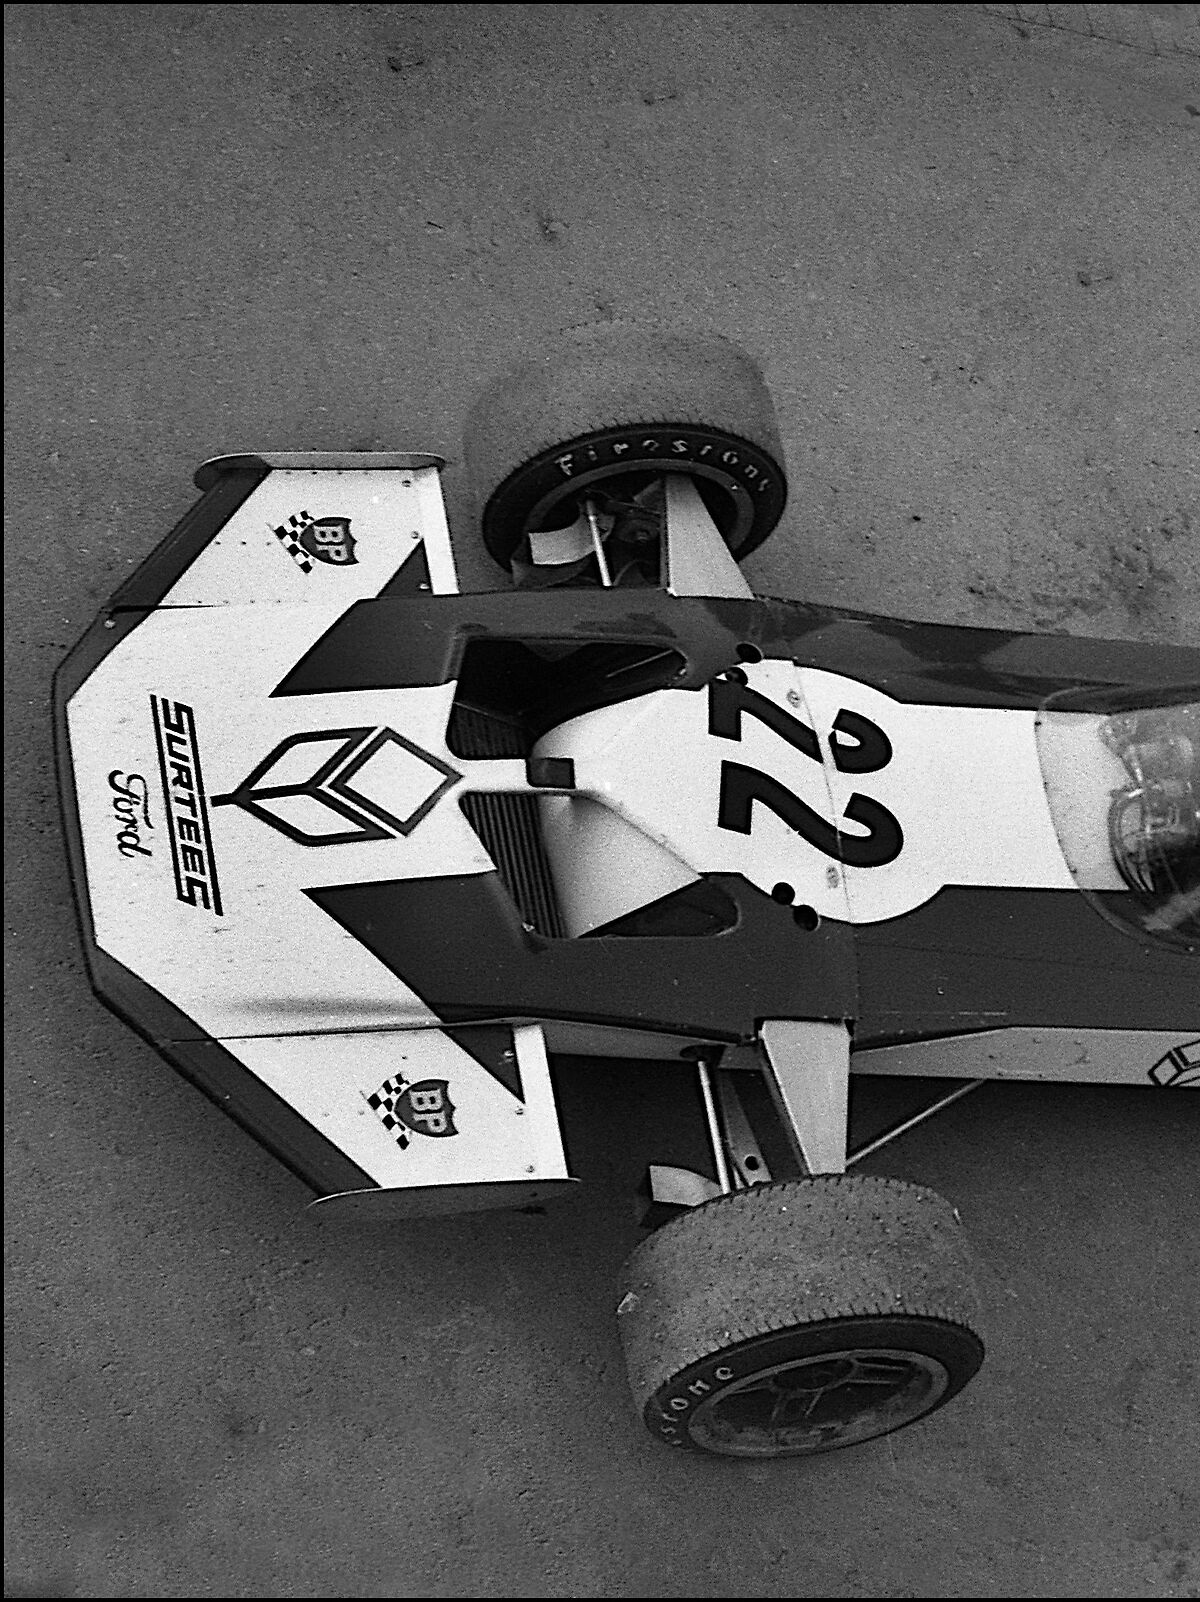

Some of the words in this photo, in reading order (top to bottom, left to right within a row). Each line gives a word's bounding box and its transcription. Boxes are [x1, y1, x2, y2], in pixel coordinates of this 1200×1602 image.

[313, 525, 350, 562] BP
[108, 769, 155, 858] Ford
[160, 697, 212, 910] SURTEES
[708, 677, 905, 868] 22
[409, 1088, 448, 1133] BP
